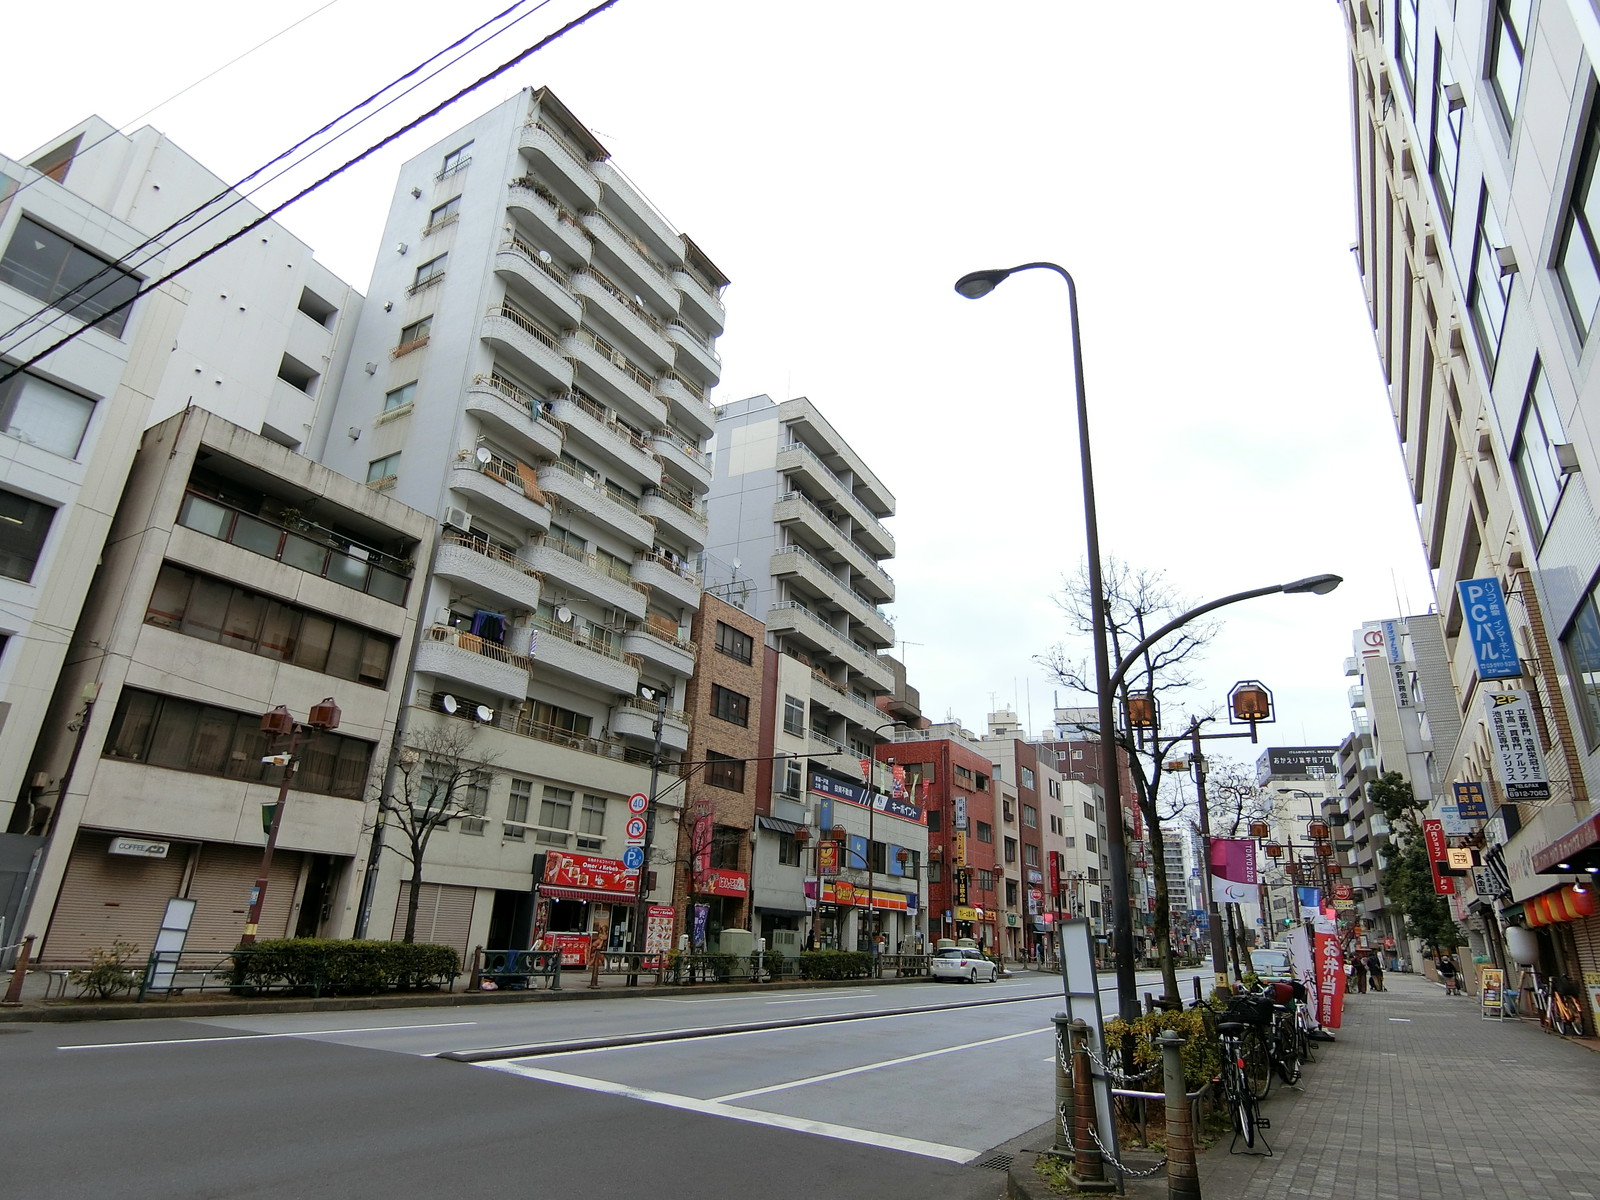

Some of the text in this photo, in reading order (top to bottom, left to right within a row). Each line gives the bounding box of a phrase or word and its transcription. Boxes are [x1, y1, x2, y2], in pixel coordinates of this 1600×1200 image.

[1485, 582, 1511, 660] パソコン教室 インターネット
[1495, 695, 1516, 704] 2F
[1517, 709, 1531, 736] 立教専門
[1492, 710, 1517, 781] 池袋地区専門 シリウス
[1504, 709, 1529, 780] 中高一貫専門 アルファ
[633, 799, 644, 808] 40
[891, 801, 917, 818] キーポイント
[119, 843, 145, 851] COFFEE
[1245, 845, 1253, 866] TOKYO
